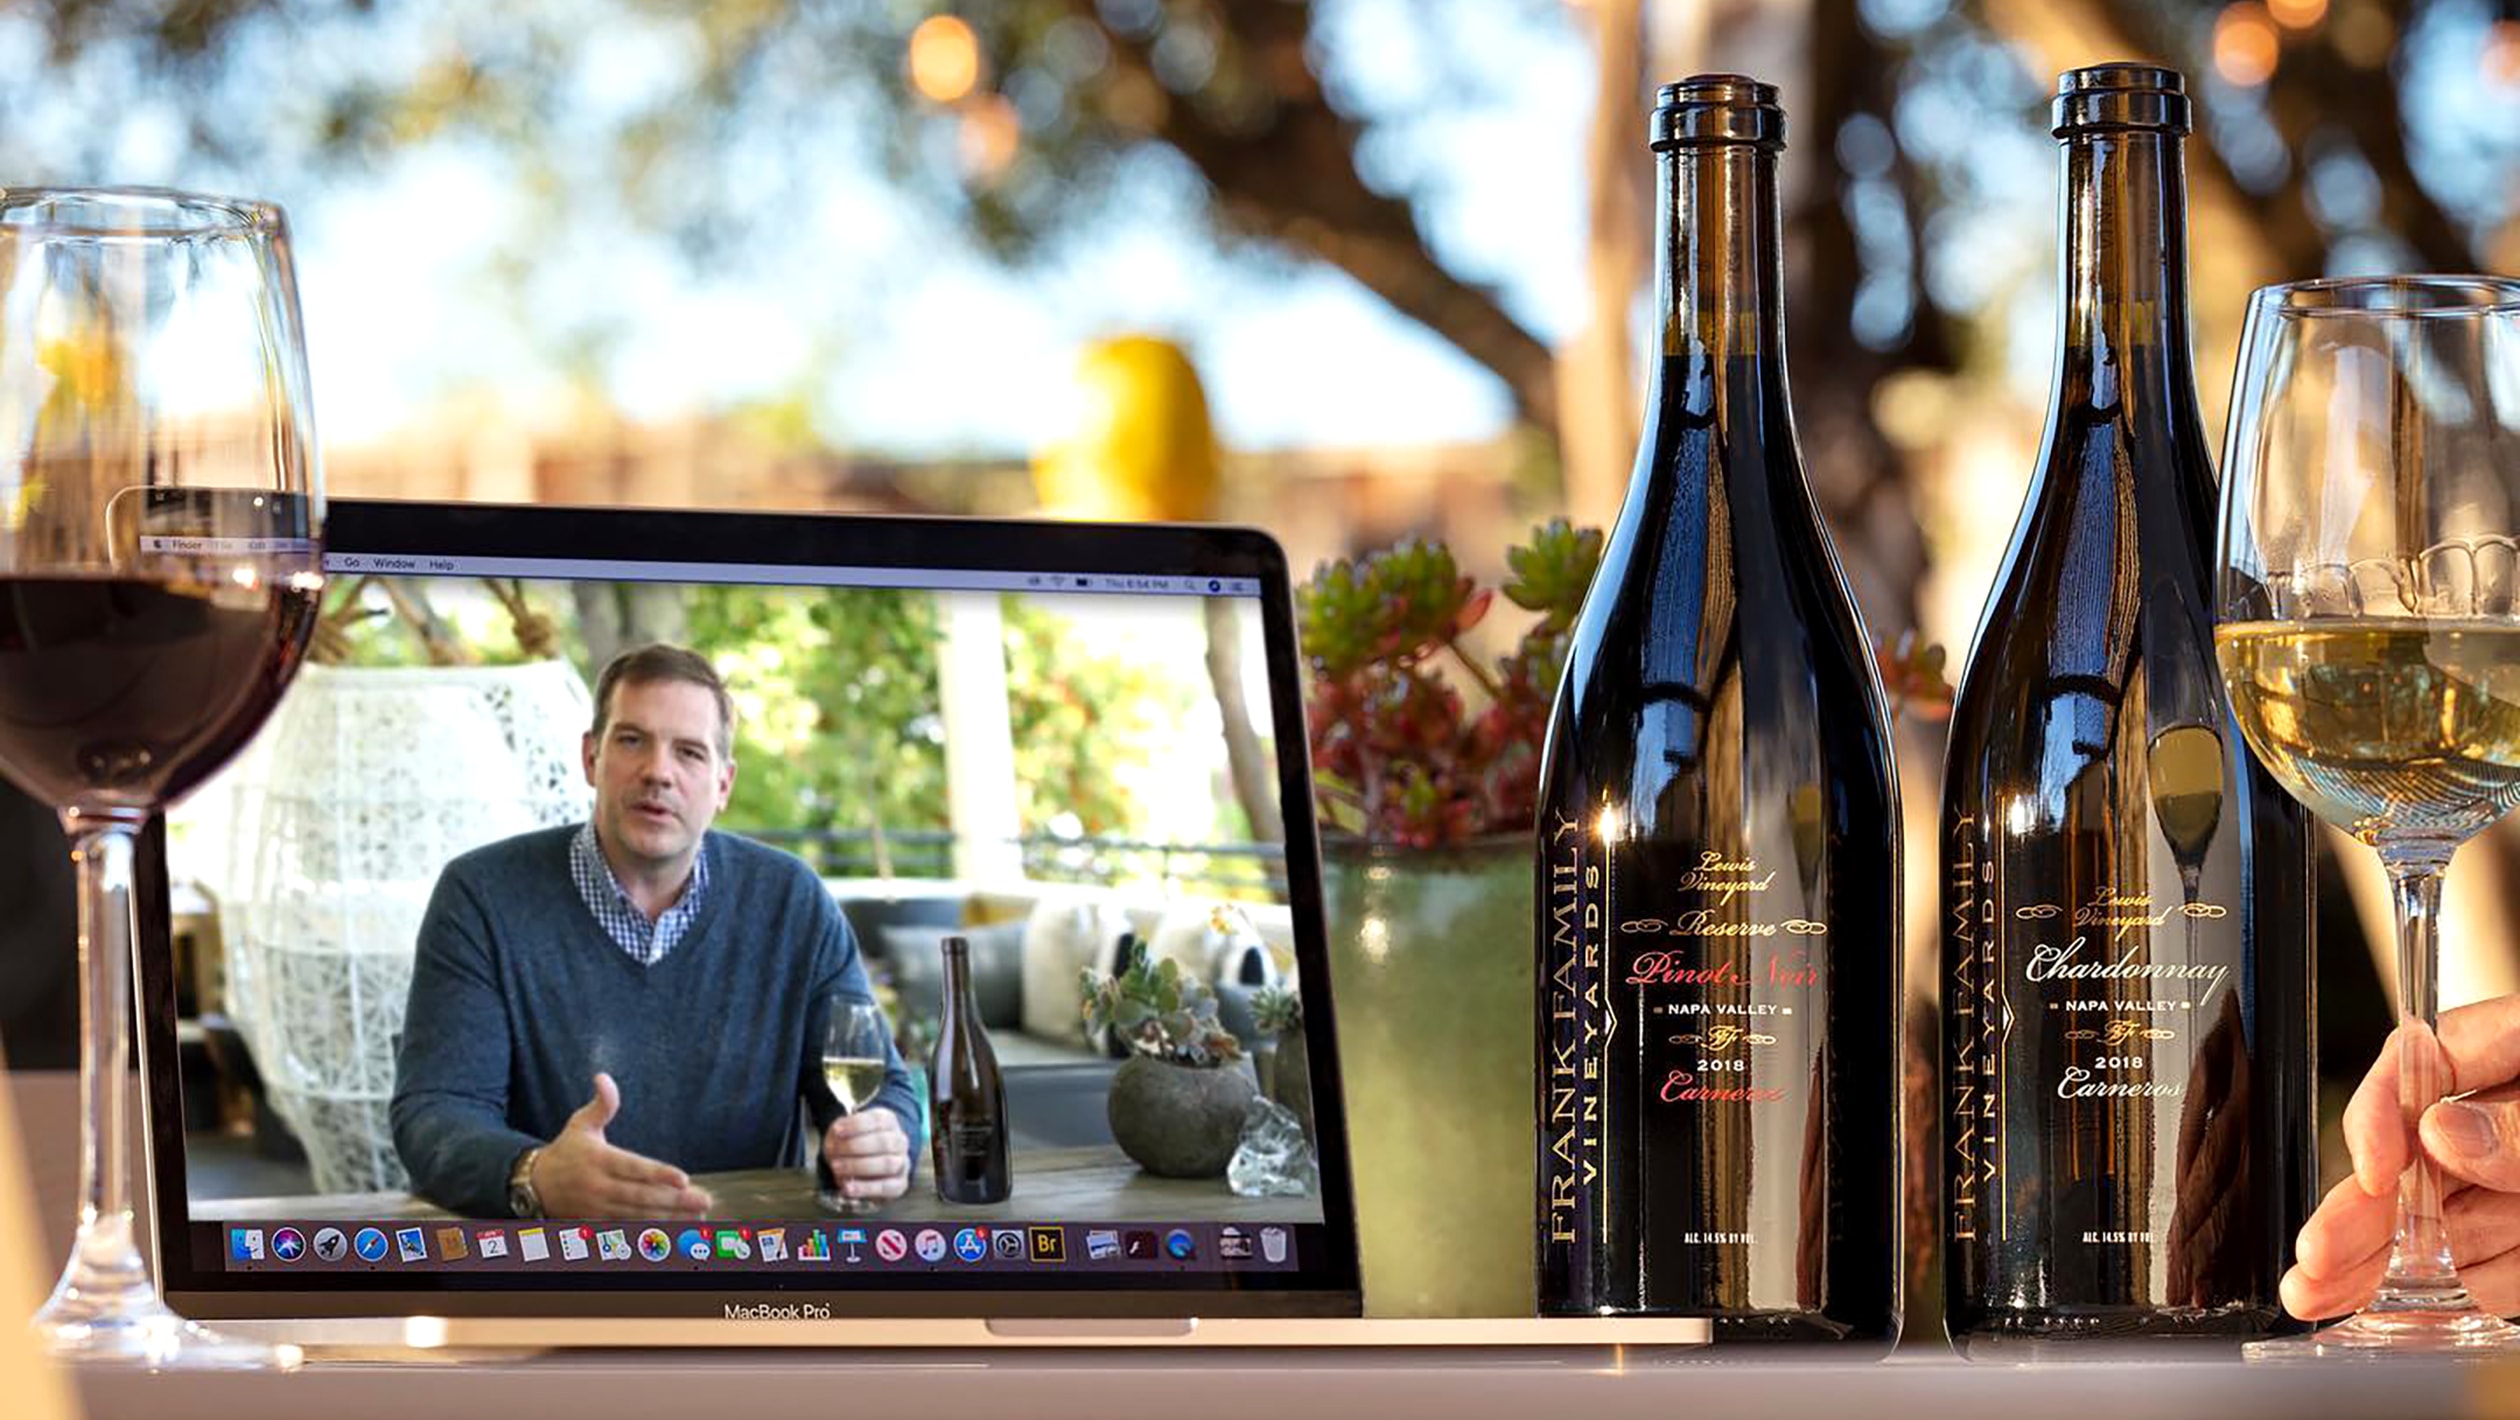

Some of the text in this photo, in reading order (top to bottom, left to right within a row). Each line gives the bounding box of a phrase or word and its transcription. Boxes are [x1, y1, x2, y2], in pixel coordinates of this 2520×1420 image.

[344, 557, 455, 571] Go Window Help
[1693, 851, 1756, 872] Lewis
[1677, 871, 1777, 906] Vineyard
[2087, 885, 2153, 907] Lewis
[1669, 909, 1777, 937] Reserve
[2074, 906, 2173, 942] Vineyard
[1625, 950, 1733, 985] Pinot
[2025, 936, 2230, 1006] Chardonnay
[1668, 1004, 1778, 1015] NAPA VALLEY
[2066, 1001, 2177, 1012] NAPA VALLEY
[1552, 806, 1579, 1244] FRANK FAMILY
[1583, 865, 1599, 1186] VINEYARDS
[1953, 803, 1976, 1242] FRANK FAMILY
[1982, 860, 1996, 1183] VINEYARDS
[1696, 1059, 1745, 1072] 2018
[2094, 1056, 2144, 1069] 2018
[2057, 1066, 2182, 1099] Carneros
[487, 1239, 498, 1254] 2
[1038, 1234, 1056, 1252] Br
[724, 1302, 831, 1319] MacBook Pro
